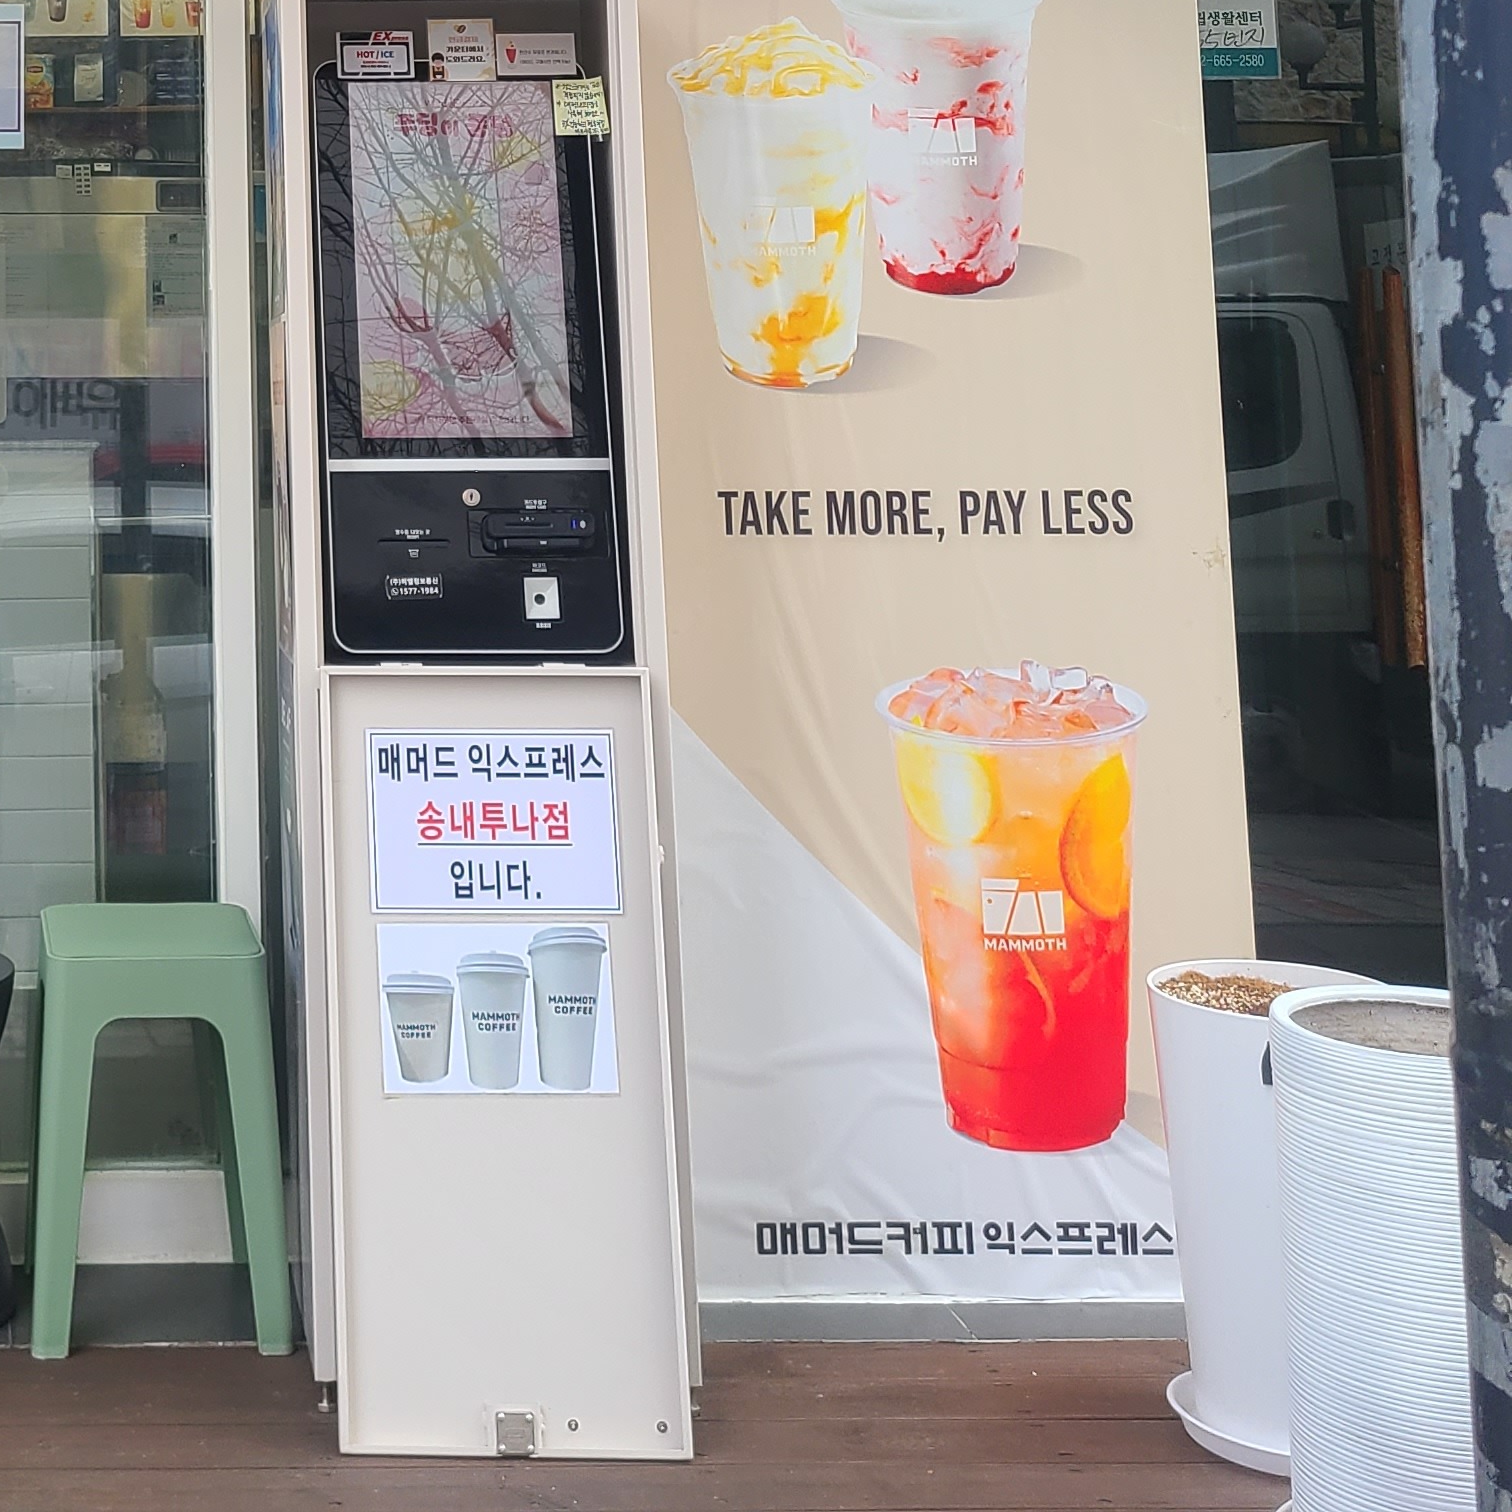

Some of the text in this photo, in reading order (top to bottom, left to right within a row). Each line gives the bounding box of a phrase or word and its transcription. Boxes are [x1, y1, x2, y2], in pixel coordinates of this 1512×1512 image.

[356, 50, 375, 59] HOT
[717, 489, 1135, 542] TAKE MORE, PAY LESS
[377, 742, 606, 783] 매머드 익스프레스
[416, 800, 571, 842] 송내투나점
[449, 859, 542, 900] 입니다.
[983, 936, 1067, 952] MAMMOTH
[548, 995, 596, 1005] MAMMOTH
[471, 1011, 521, 1021] MAMMOTH
[553, 1006, 594, 1016] COFFEE
[396, 1023, 437, 1031] MAMMOTH
[477, 1022, 517, 1032] COFFEE
[400, 1031, 432, 1039] COFFEE
[755, 1220, 1175, 1256] 매머드커피 익스프레스
